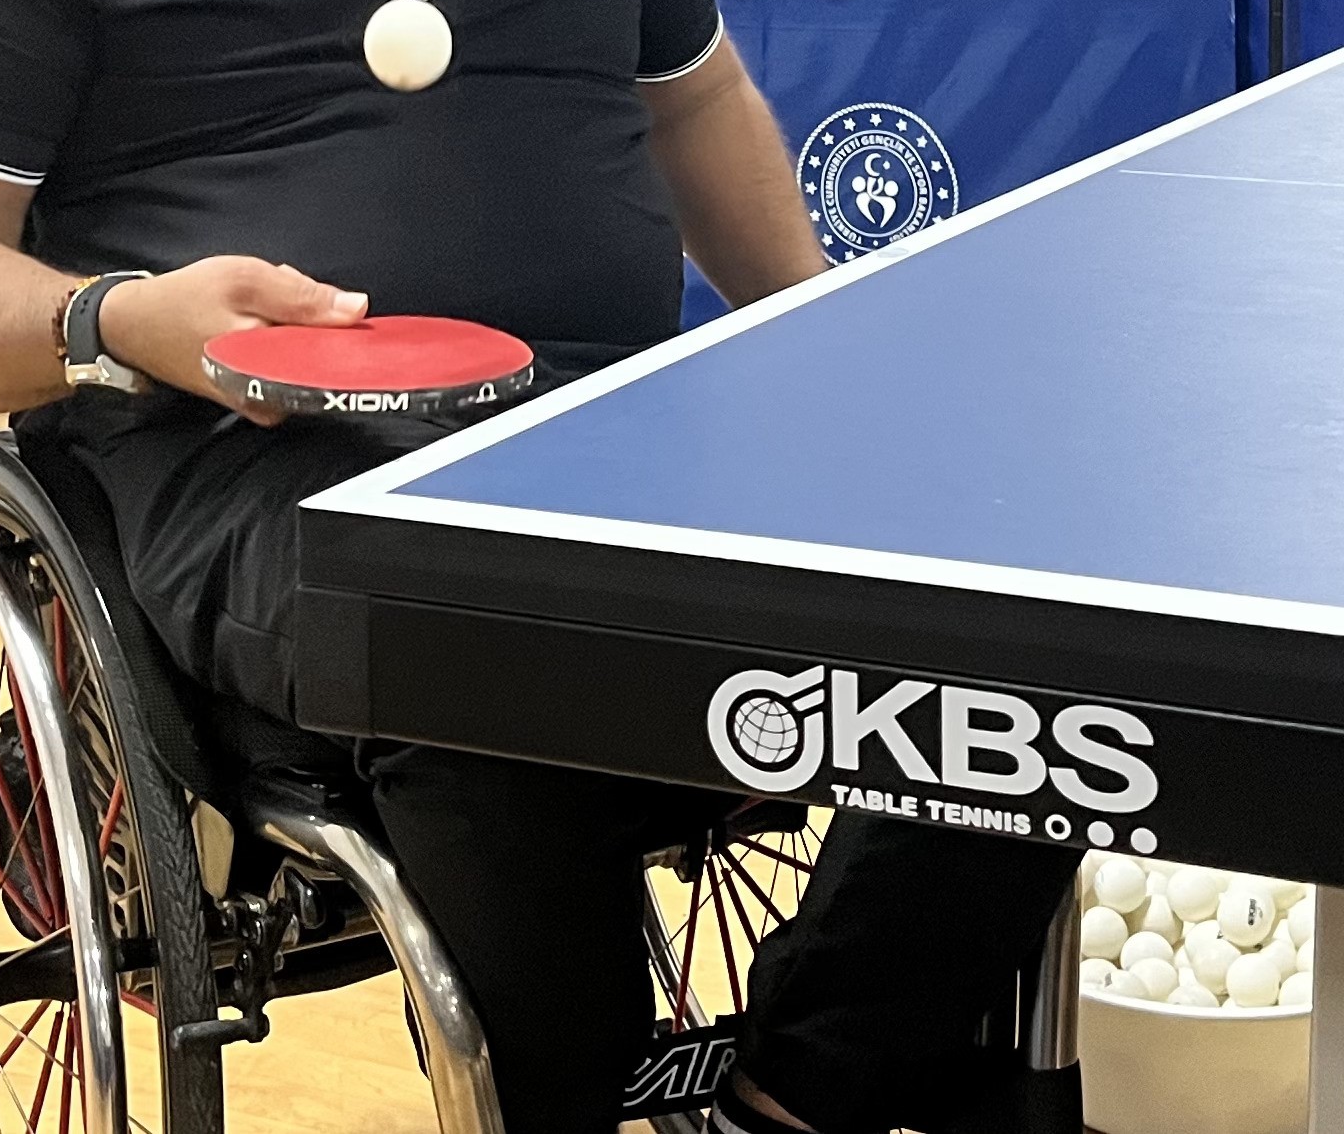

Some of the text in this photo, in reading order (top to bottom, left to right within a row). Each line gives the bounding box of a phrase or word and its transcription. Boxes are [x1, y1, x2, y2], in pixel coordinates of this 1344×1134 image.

[323, 392, 409, 412] XIOM
[832, 784, 1032, 835] TABLE TENNIS
